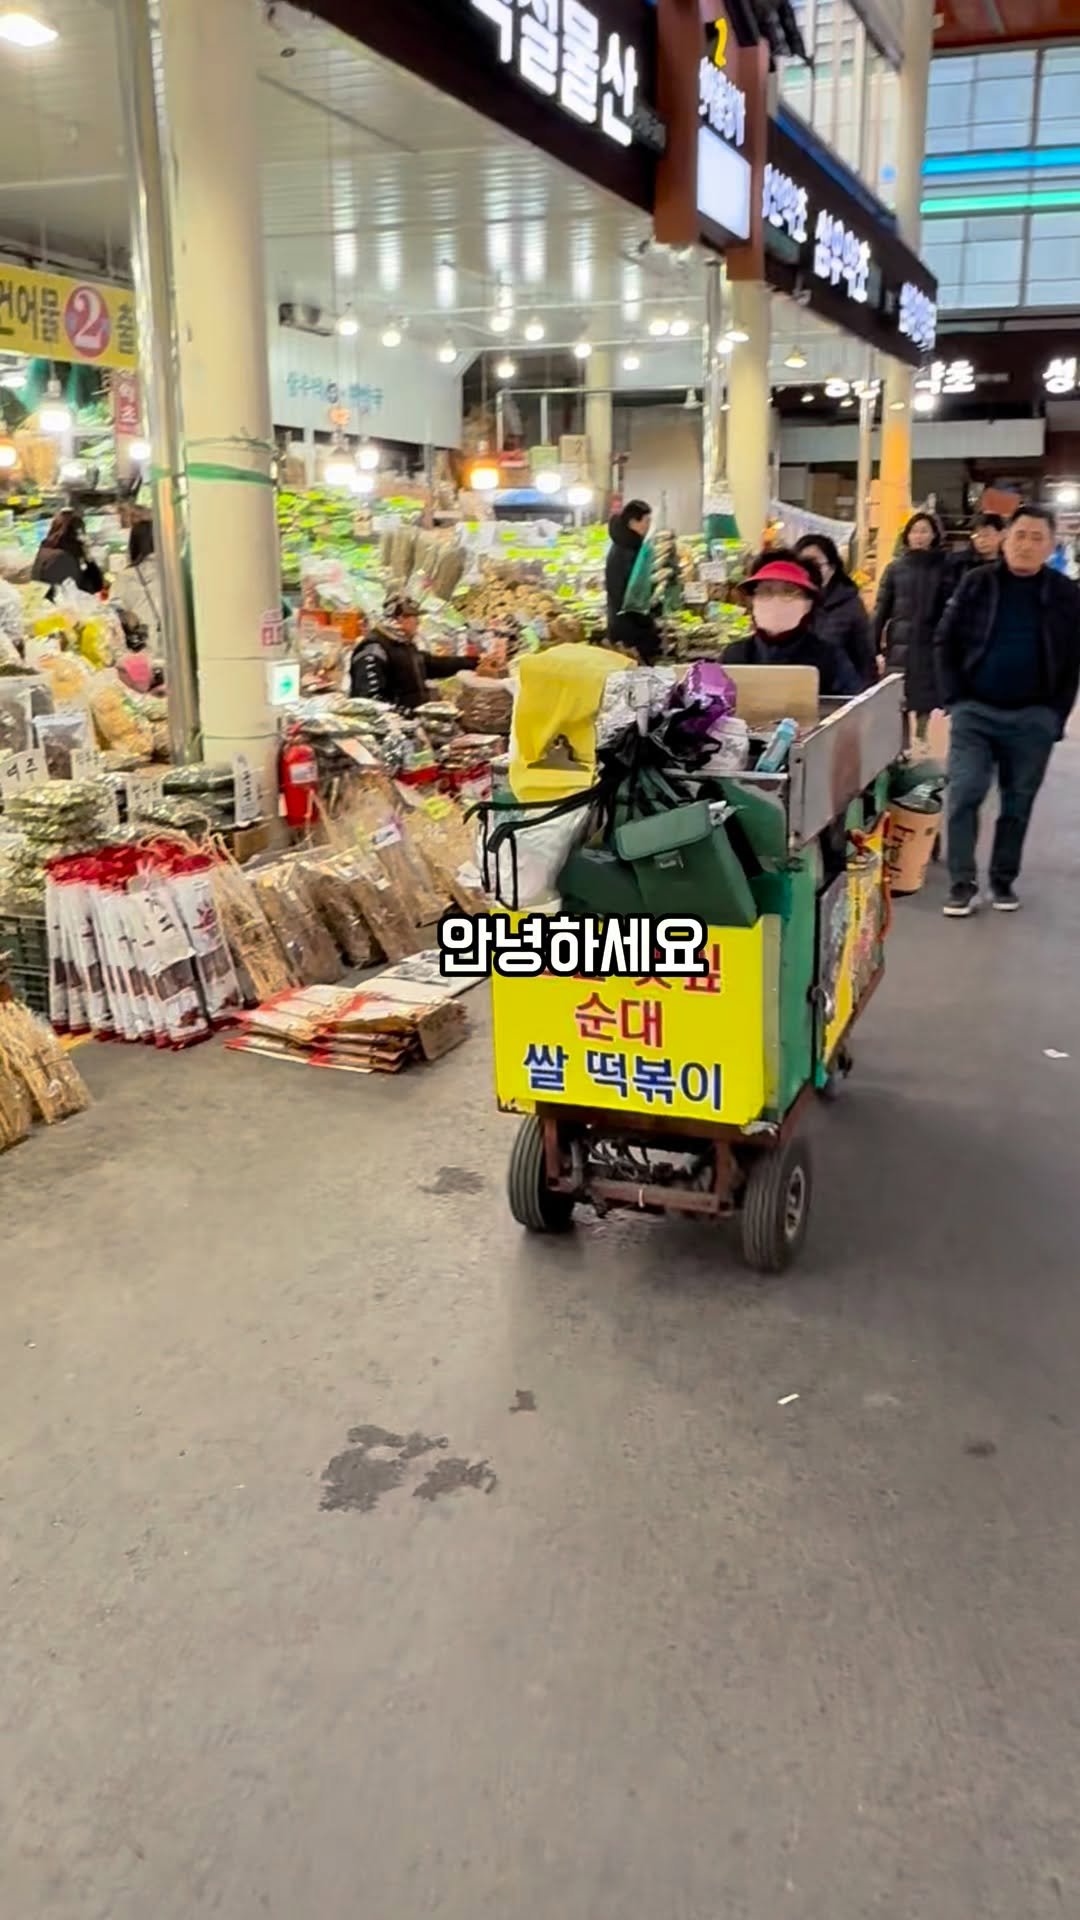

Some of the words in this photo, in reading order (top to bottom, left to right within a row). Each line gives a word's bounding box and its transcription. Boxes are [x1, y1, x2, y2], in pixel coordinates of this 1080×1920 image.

[575, 991, 664, 1048] 순대
[523, 1043, 569, 1092] 쌀
[586, 1049, 722, 1111] 떡볶이
